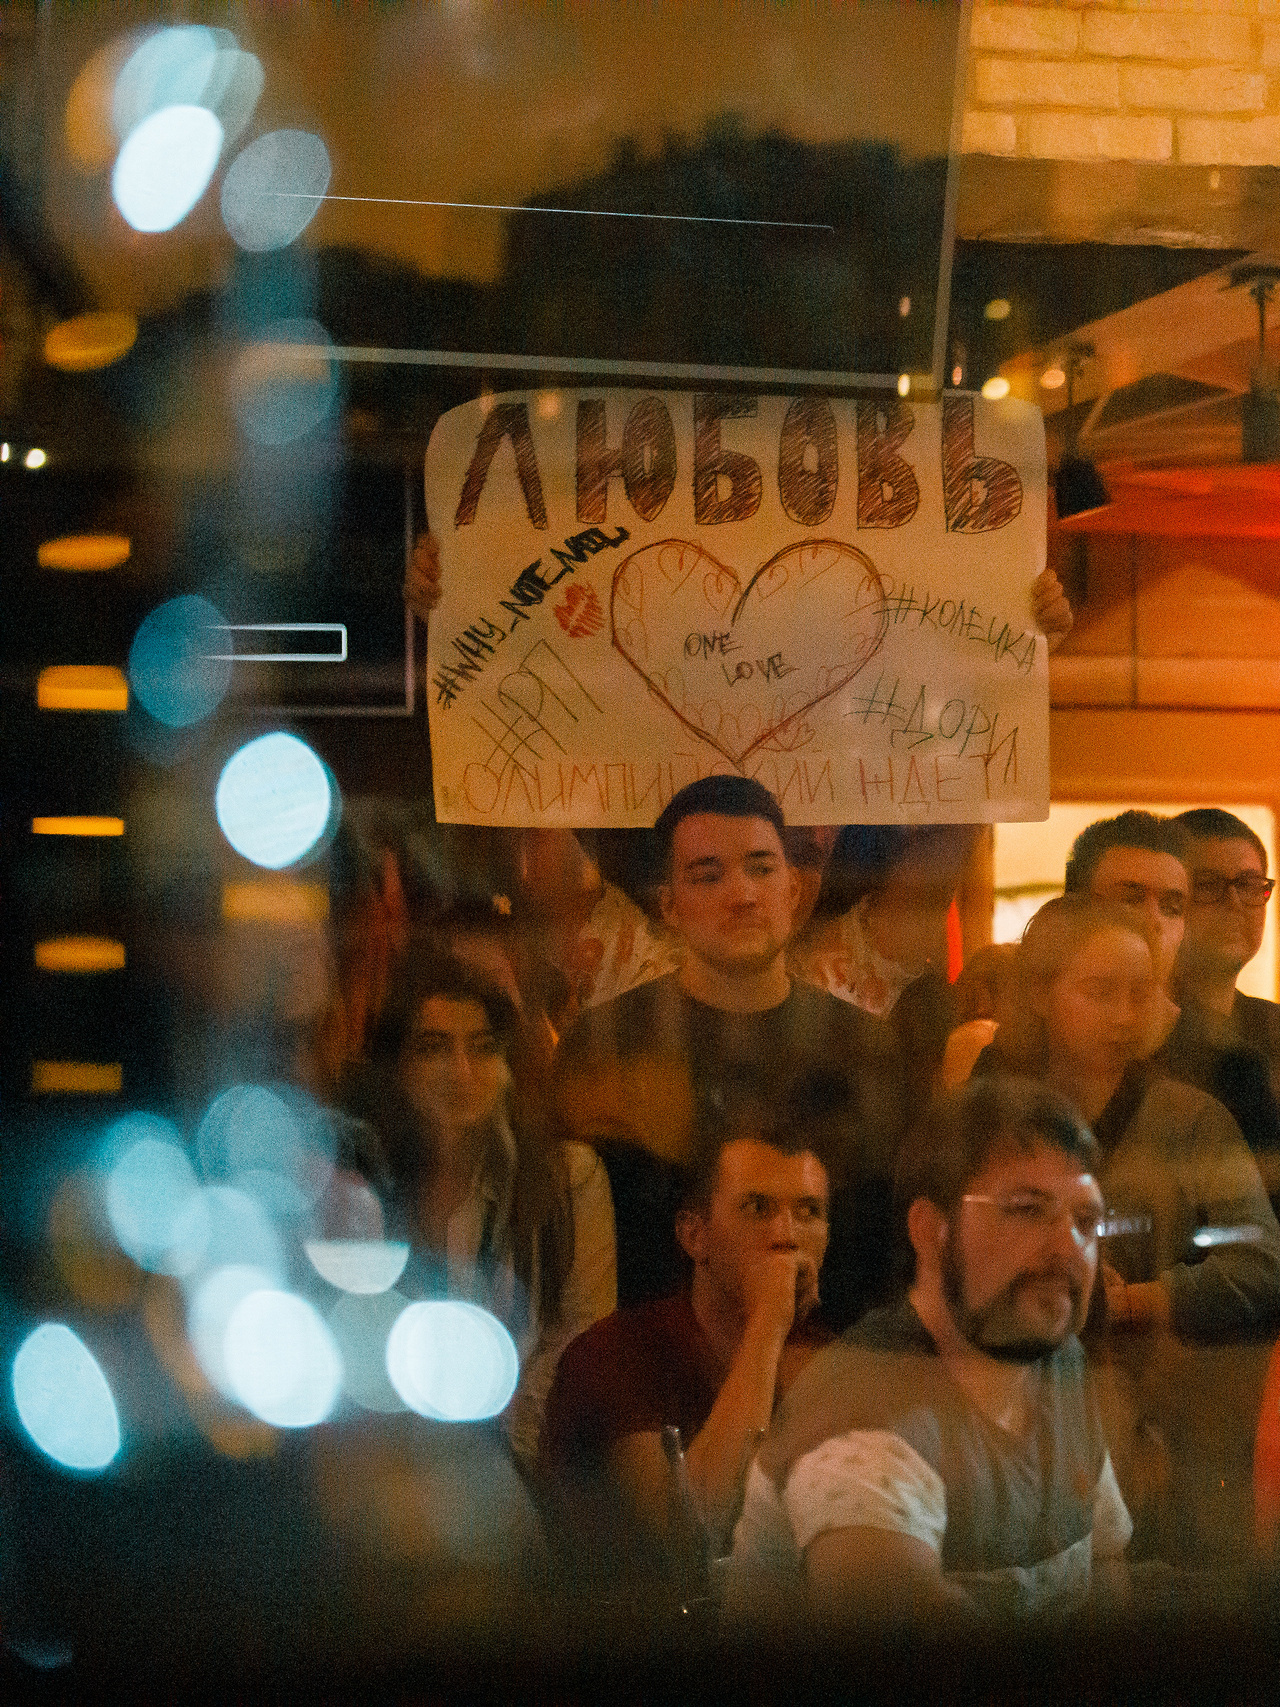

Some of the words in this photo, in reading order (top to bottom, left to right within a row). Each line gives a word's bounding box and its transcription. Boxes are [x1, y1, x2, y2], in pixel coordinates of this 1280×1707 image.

[455, 391, 1023, 534] ЛЮБОВЬ
[684, 630, 744, 660] ONE
[722, 652, 800, 688] LOVE
